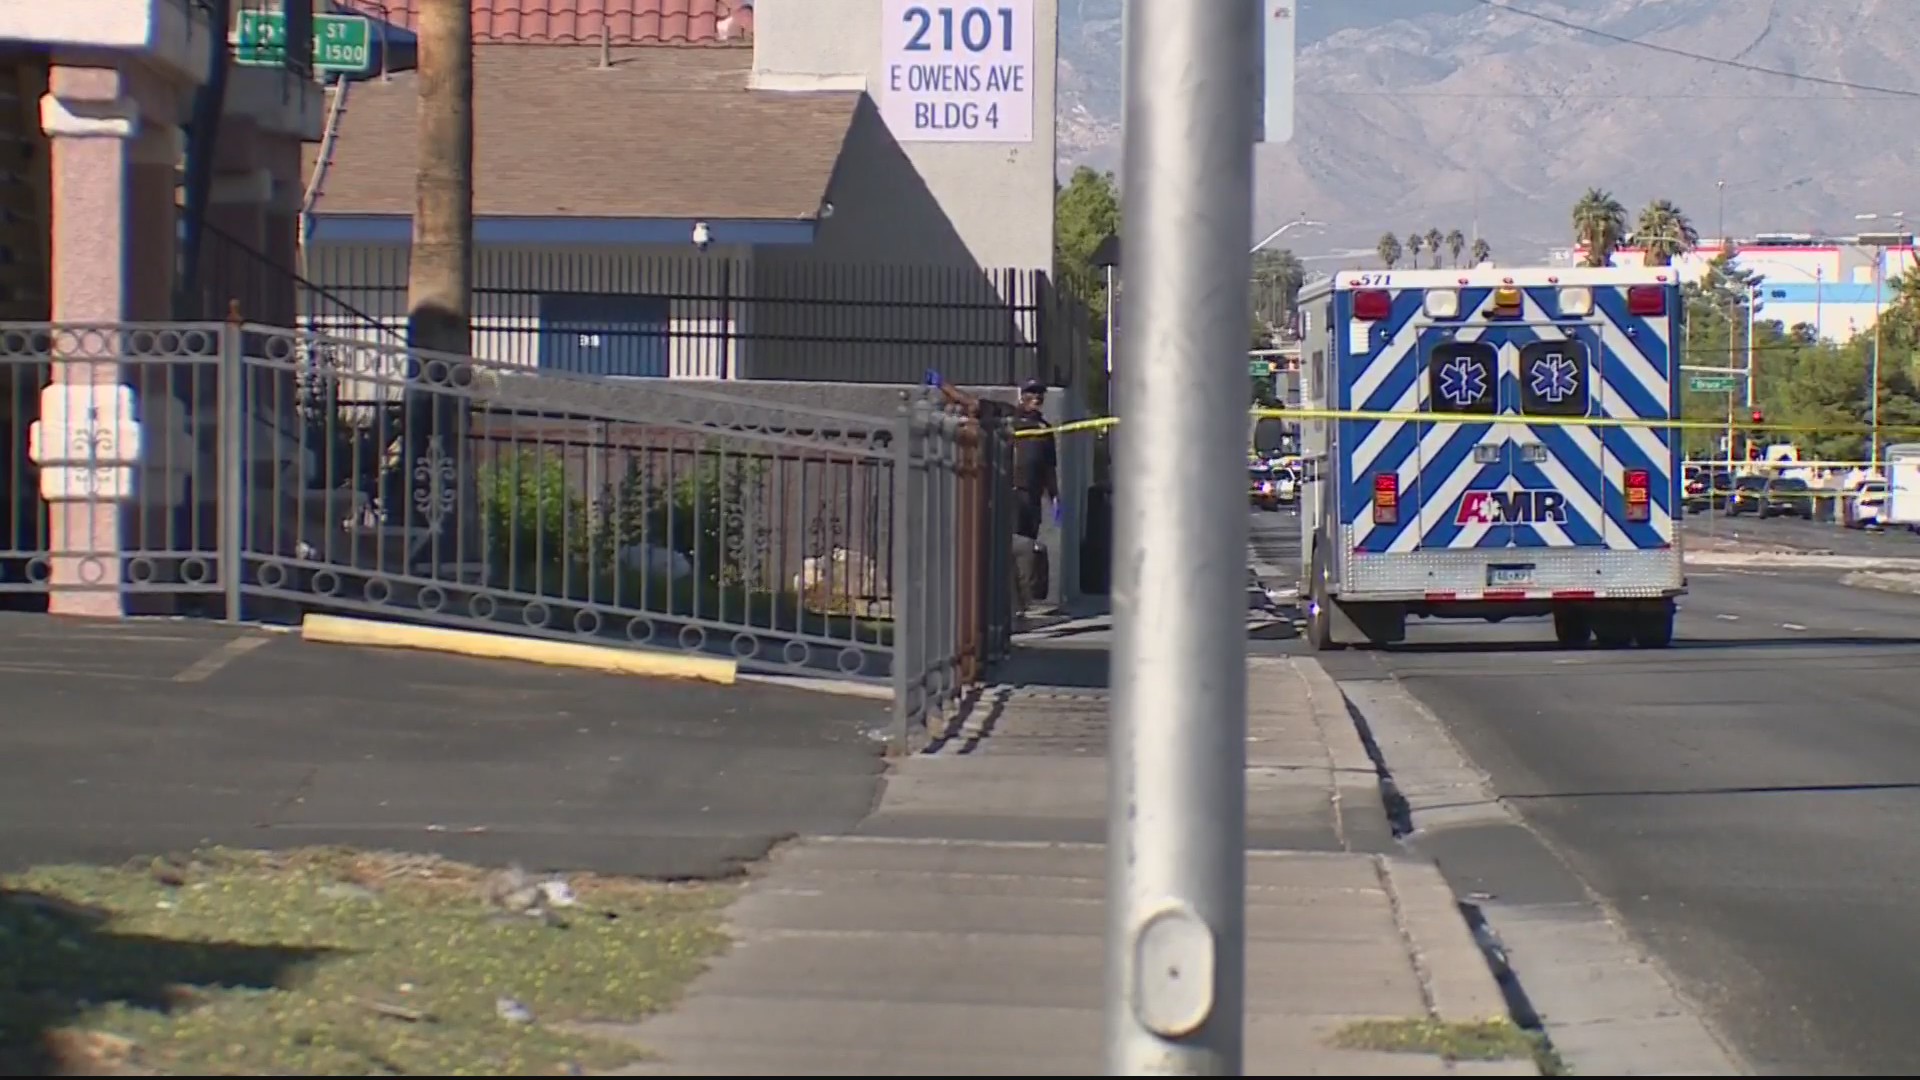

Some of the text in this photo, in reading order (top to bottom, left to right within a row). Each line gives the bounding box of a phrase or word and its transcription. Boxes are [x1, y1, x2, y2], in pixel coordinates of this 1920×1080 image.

[327, 22, 346, 39] ST
[902, 6, 1013, 52] 2101
[326, 44, 363, 61] 1500
[890, 64, 1024, 92] E OWENS AVE
[915, 102, 999, 129] BLDG 4
[1361, 274, 1391, 286] 571
[1455, 490, 1568, 524] AMR
